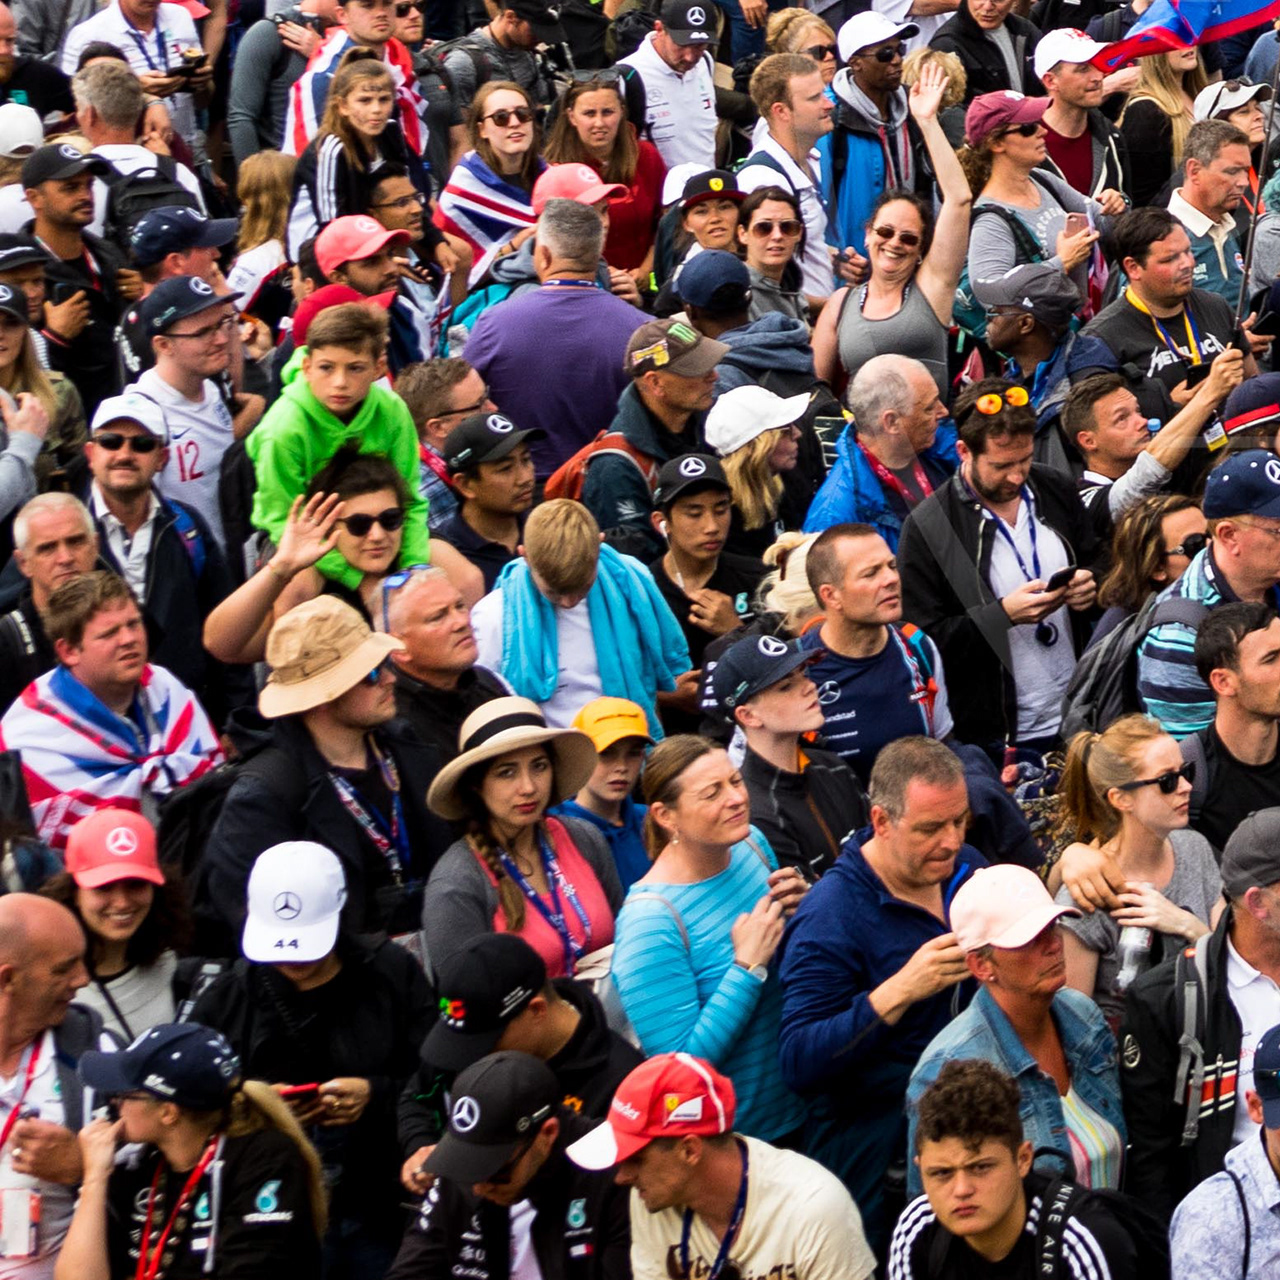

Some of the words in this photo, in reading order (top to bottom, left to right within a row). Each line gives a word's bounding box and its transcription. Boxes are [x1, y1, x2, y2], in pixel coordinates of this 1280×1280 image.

[175, 438, 205, 482] 12
[273, 938, 300, 950] 44
[1047, 1183, 1074, 1224] NIKE
[1041, 1234, 1056, 1274] AIR
